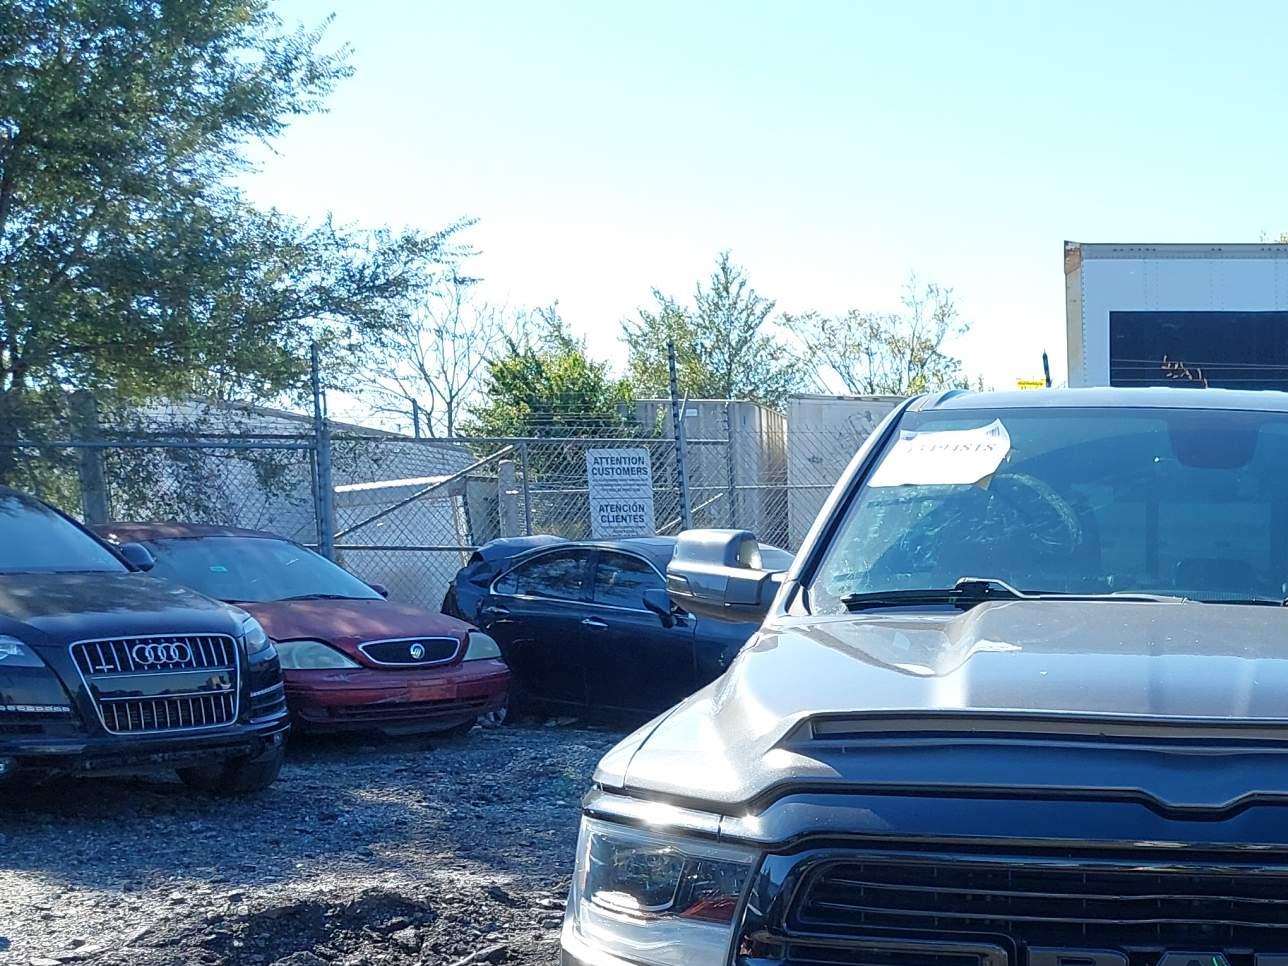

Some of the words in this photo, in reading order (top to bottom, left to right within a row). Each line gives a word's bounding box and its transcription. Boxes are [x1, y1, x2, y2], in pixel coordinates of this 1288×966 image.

[593, 456, 645, 465] ATTENTION
[591, 467, 649, 476] CUSTOMERS
[599, 502, 645, 513] ATENCIÓN
[600, 514, 645, 523] CLIENTES
